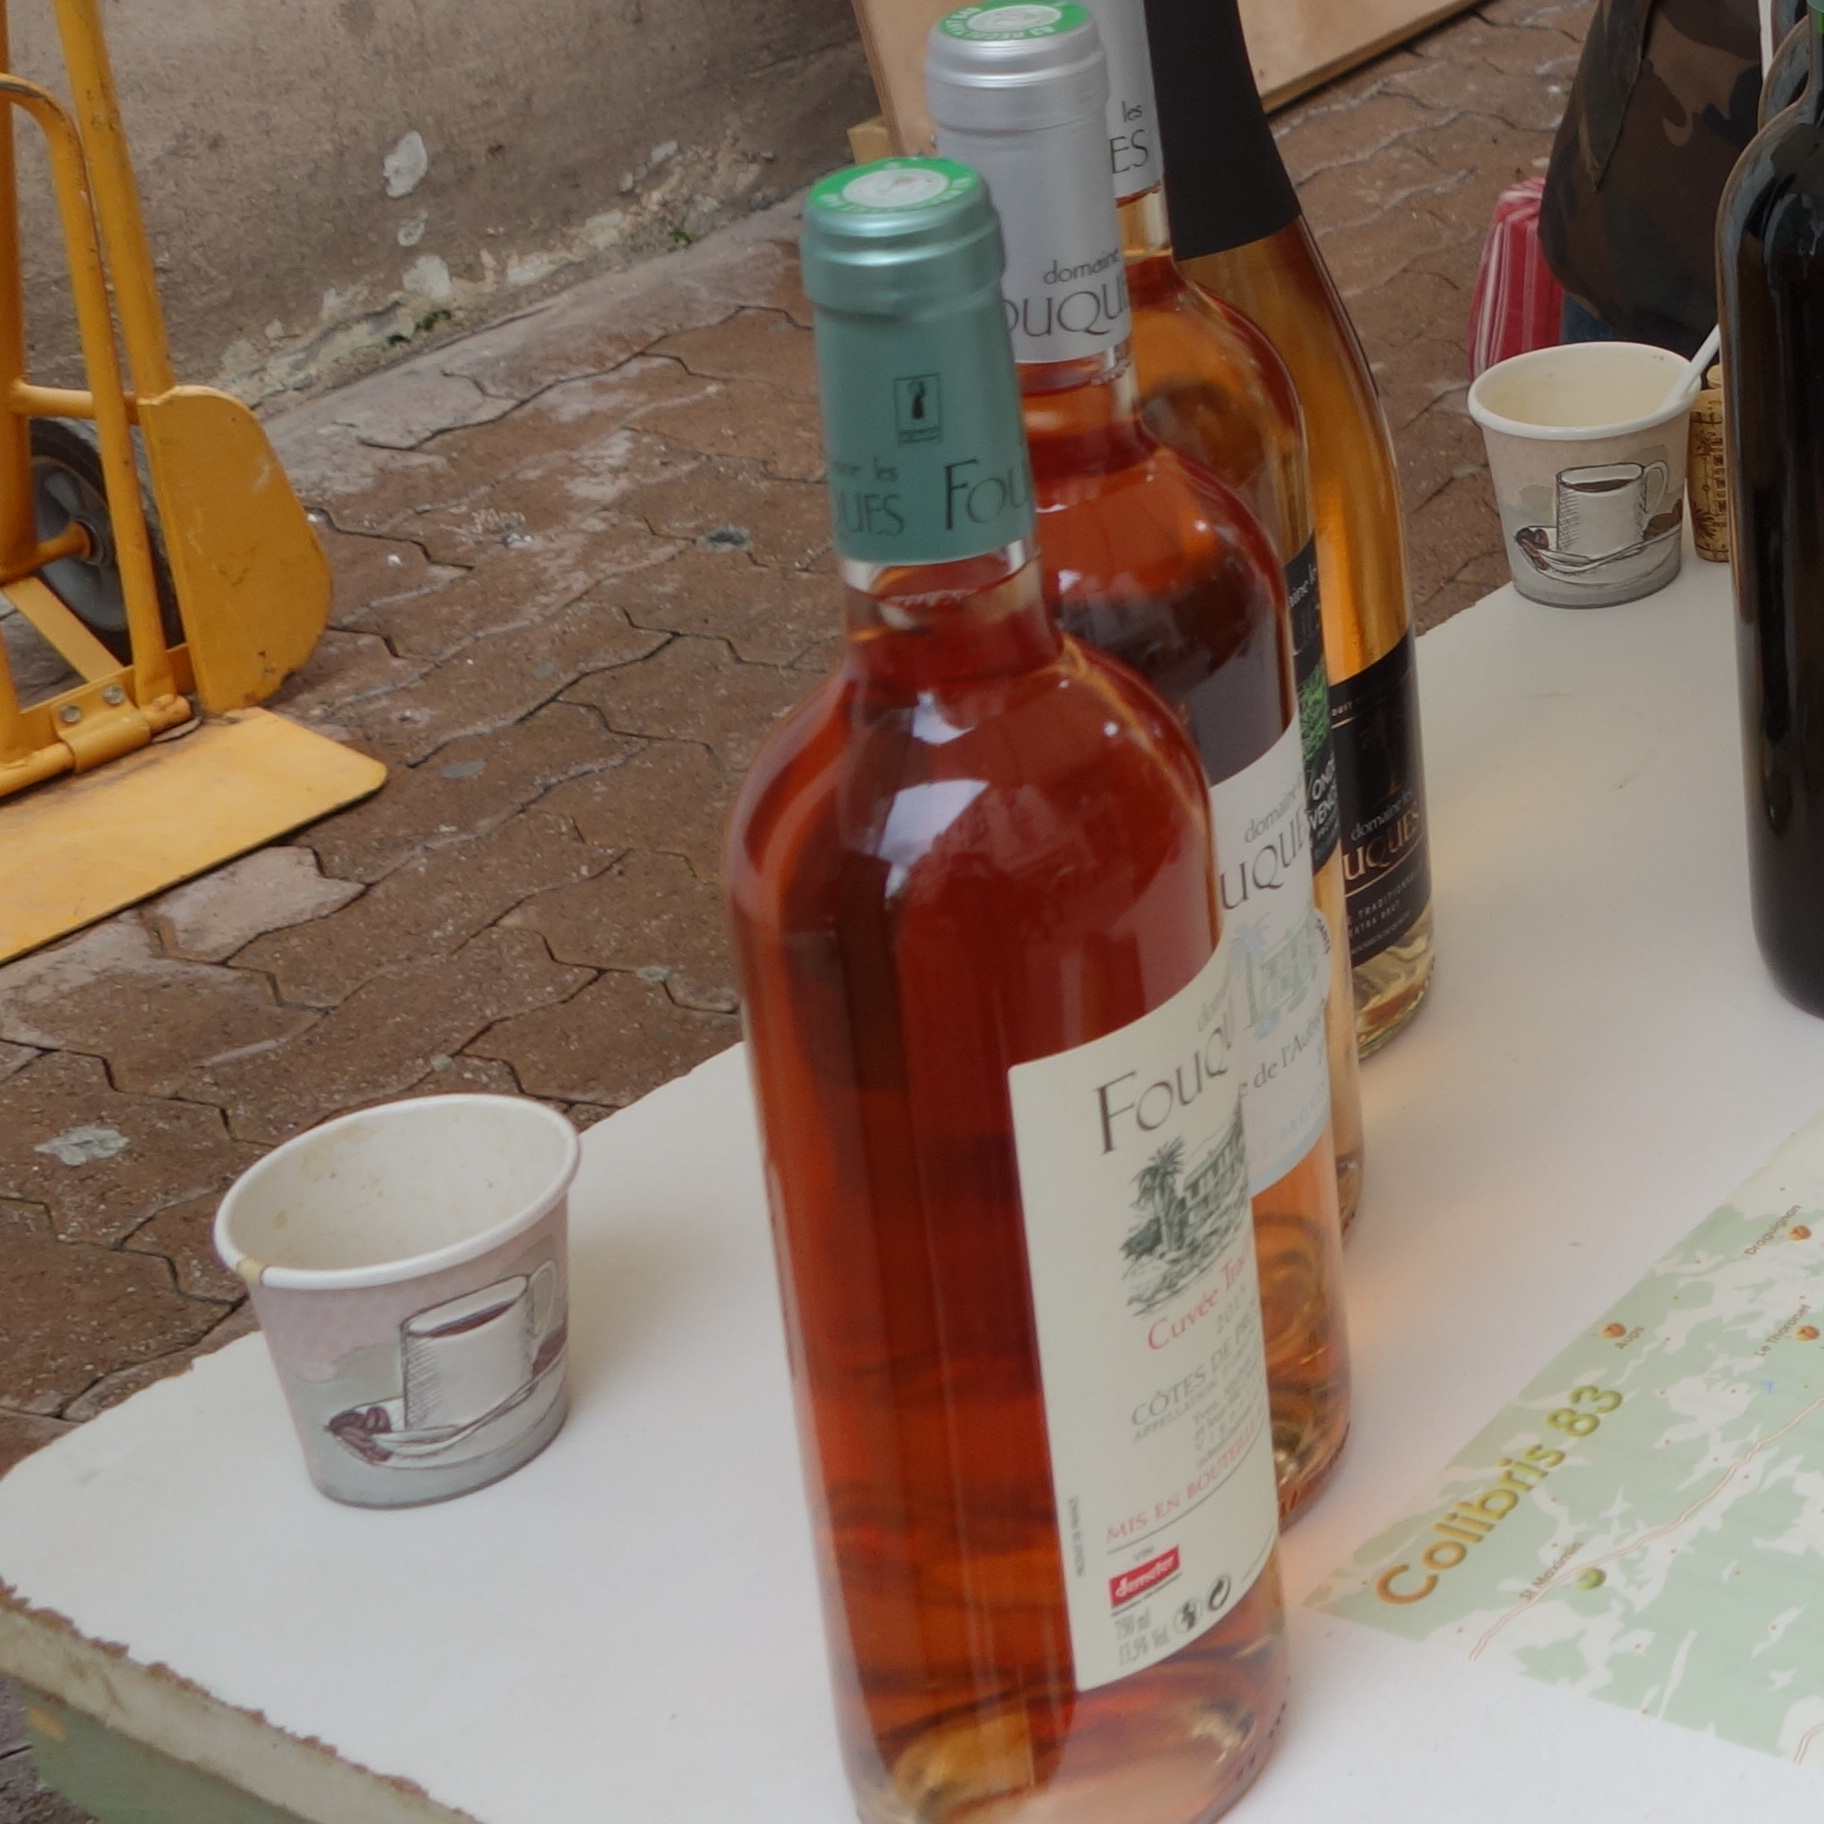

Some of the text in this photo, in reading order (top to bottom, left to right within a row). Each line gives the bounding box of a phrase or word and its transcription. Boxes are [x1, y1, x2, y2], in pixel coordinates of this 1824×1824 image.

[1745, 1206, 1801, 1255] Draguignan
[1615, 1327, 1644, 1349] Aups
[1765, 1305, 1810, 1343] Thoronet
[1105, 1492, 1181, 1546] MIS EN
[1376, 1386, 1622, 1605] Colibris 83
[1532, 1542, 1583, 1588] Maximin
